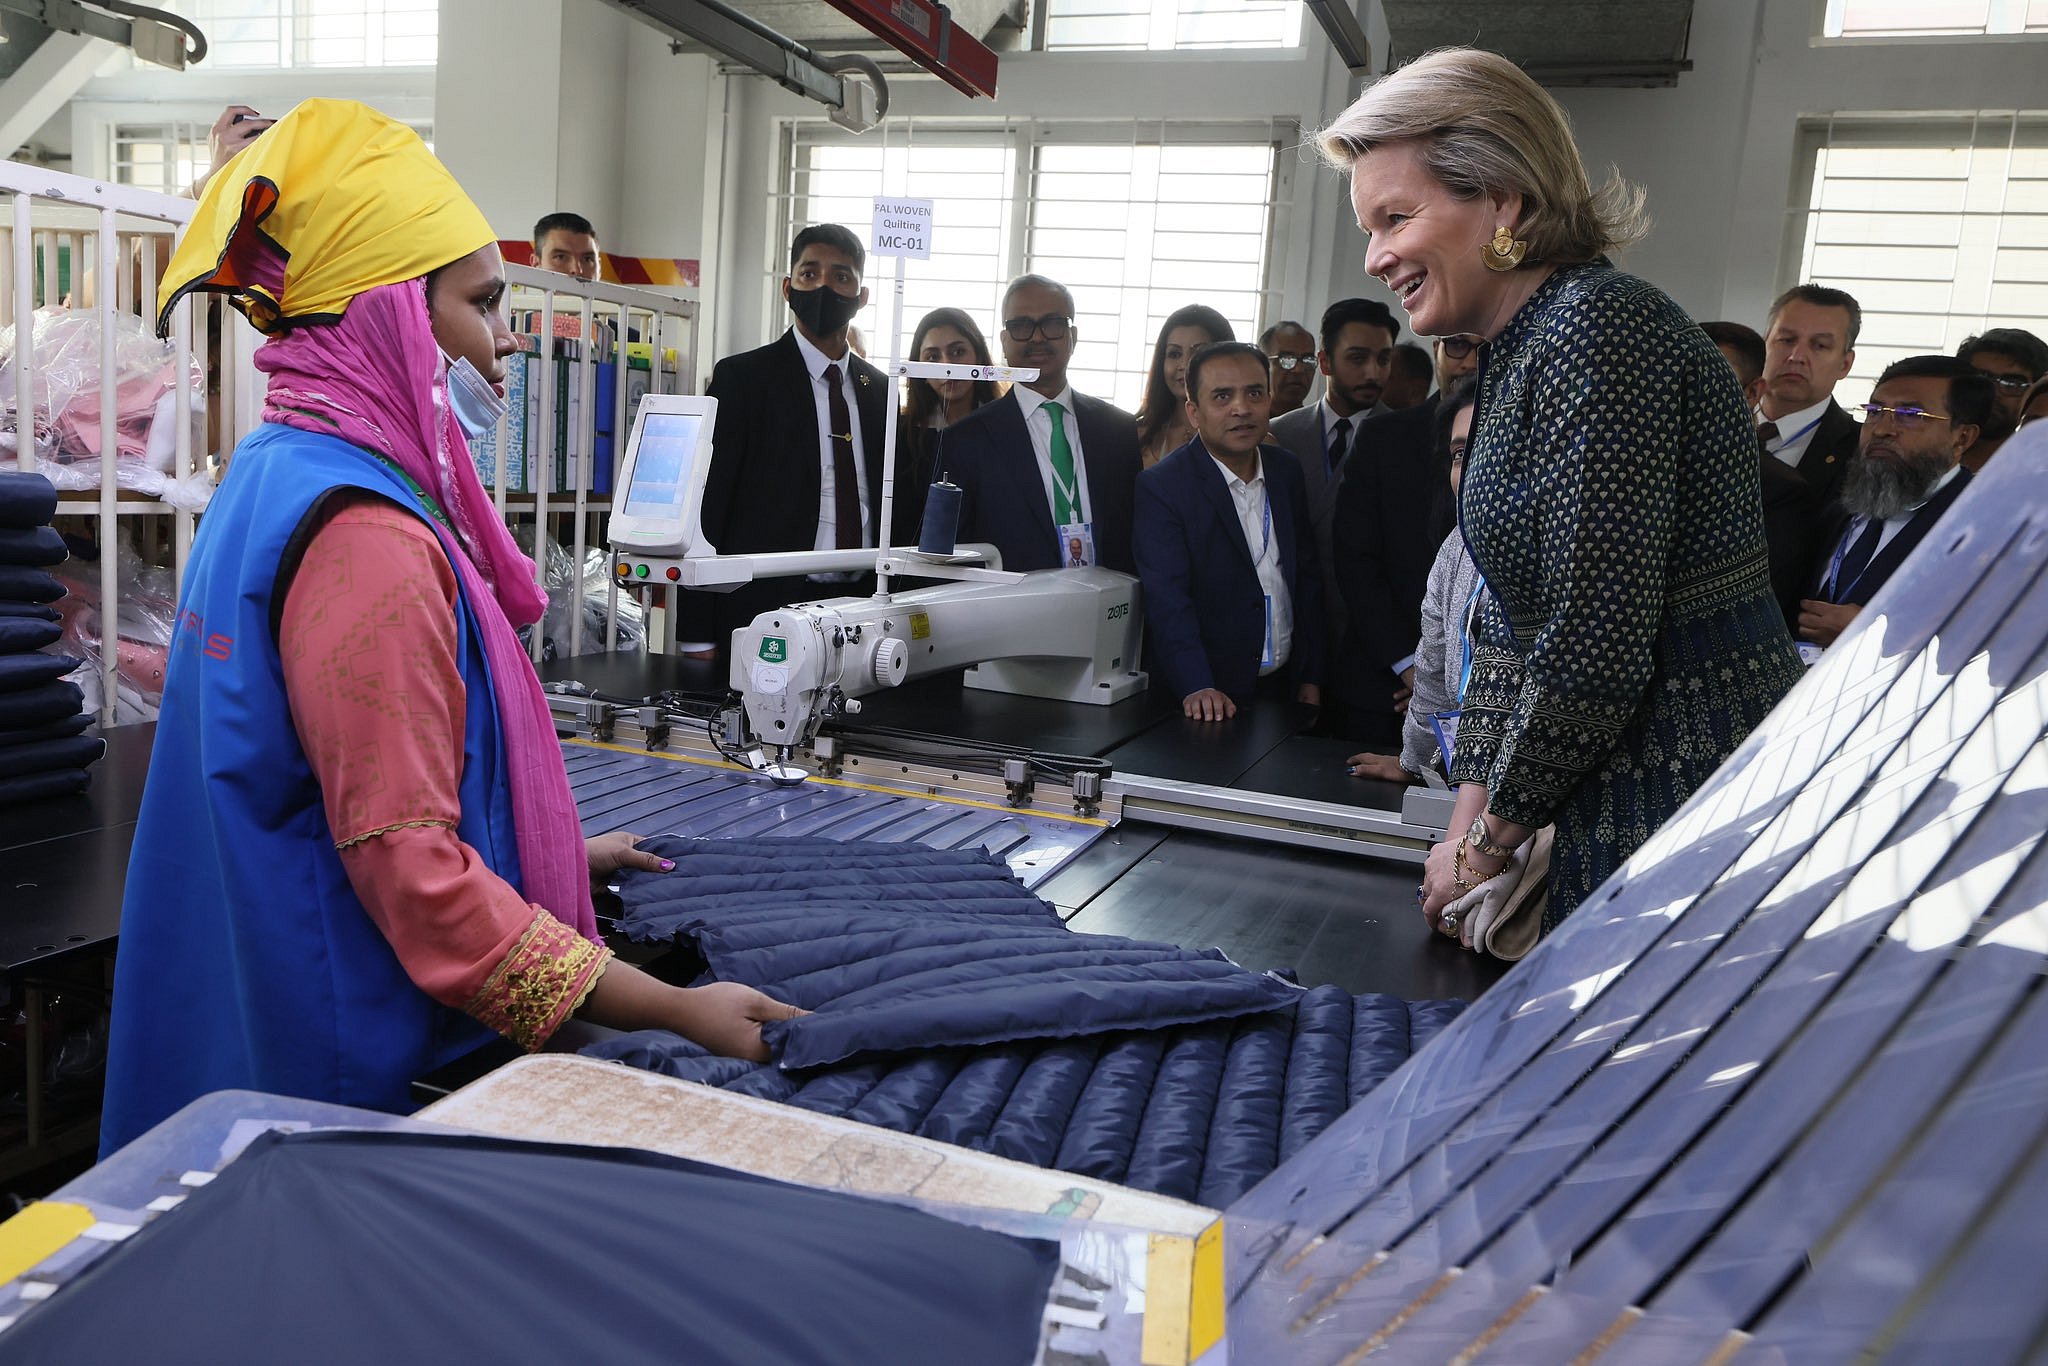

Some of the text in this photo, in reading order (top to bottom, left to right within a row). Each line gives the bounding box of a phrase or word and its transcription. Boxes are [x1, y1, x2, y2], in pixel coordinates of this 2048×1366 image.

[875, 204, 931, 216] FAL WOVEN
[883, 219, 921, 232] Quilting
[878, 235, 924, 251] MC-01
[1107, 602, 1129, 620] ZOJE
